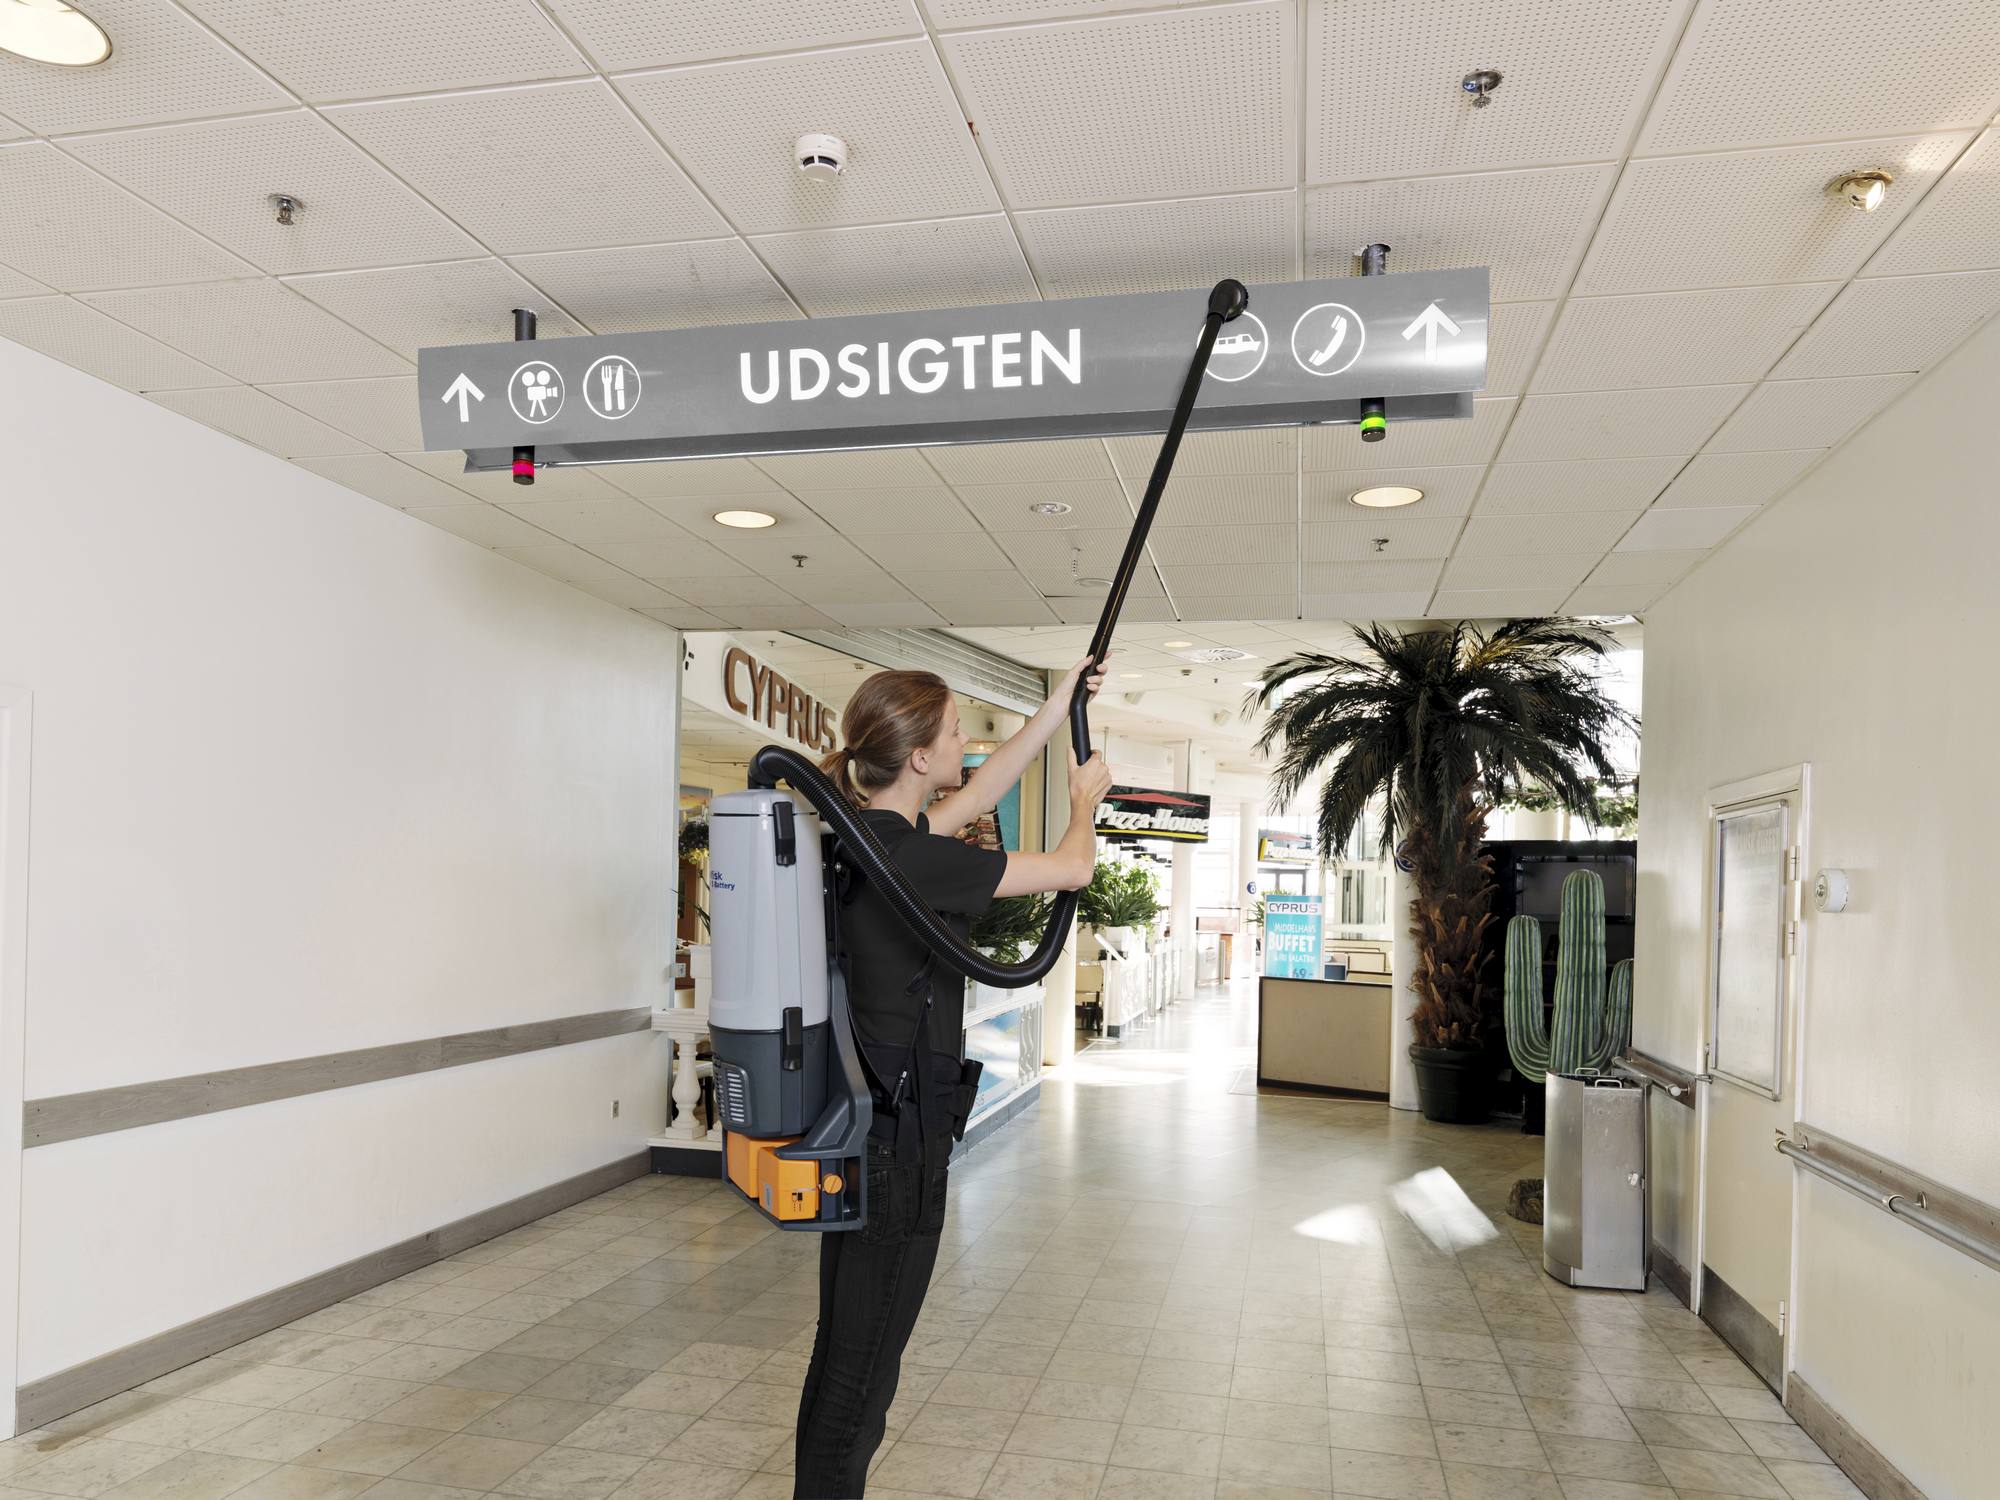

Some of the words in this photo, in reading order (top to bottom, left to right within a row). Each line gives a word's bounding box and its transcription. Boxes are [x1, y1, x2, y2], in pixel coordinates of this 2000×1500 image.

[740, 328, 1081, 404] UDSIGTEN
[724, 647, 837, 754] CYPRUS
[1268, 903, 1318, 914] CYPRUS
[1268, 931, 1316, 952] BUFFET
